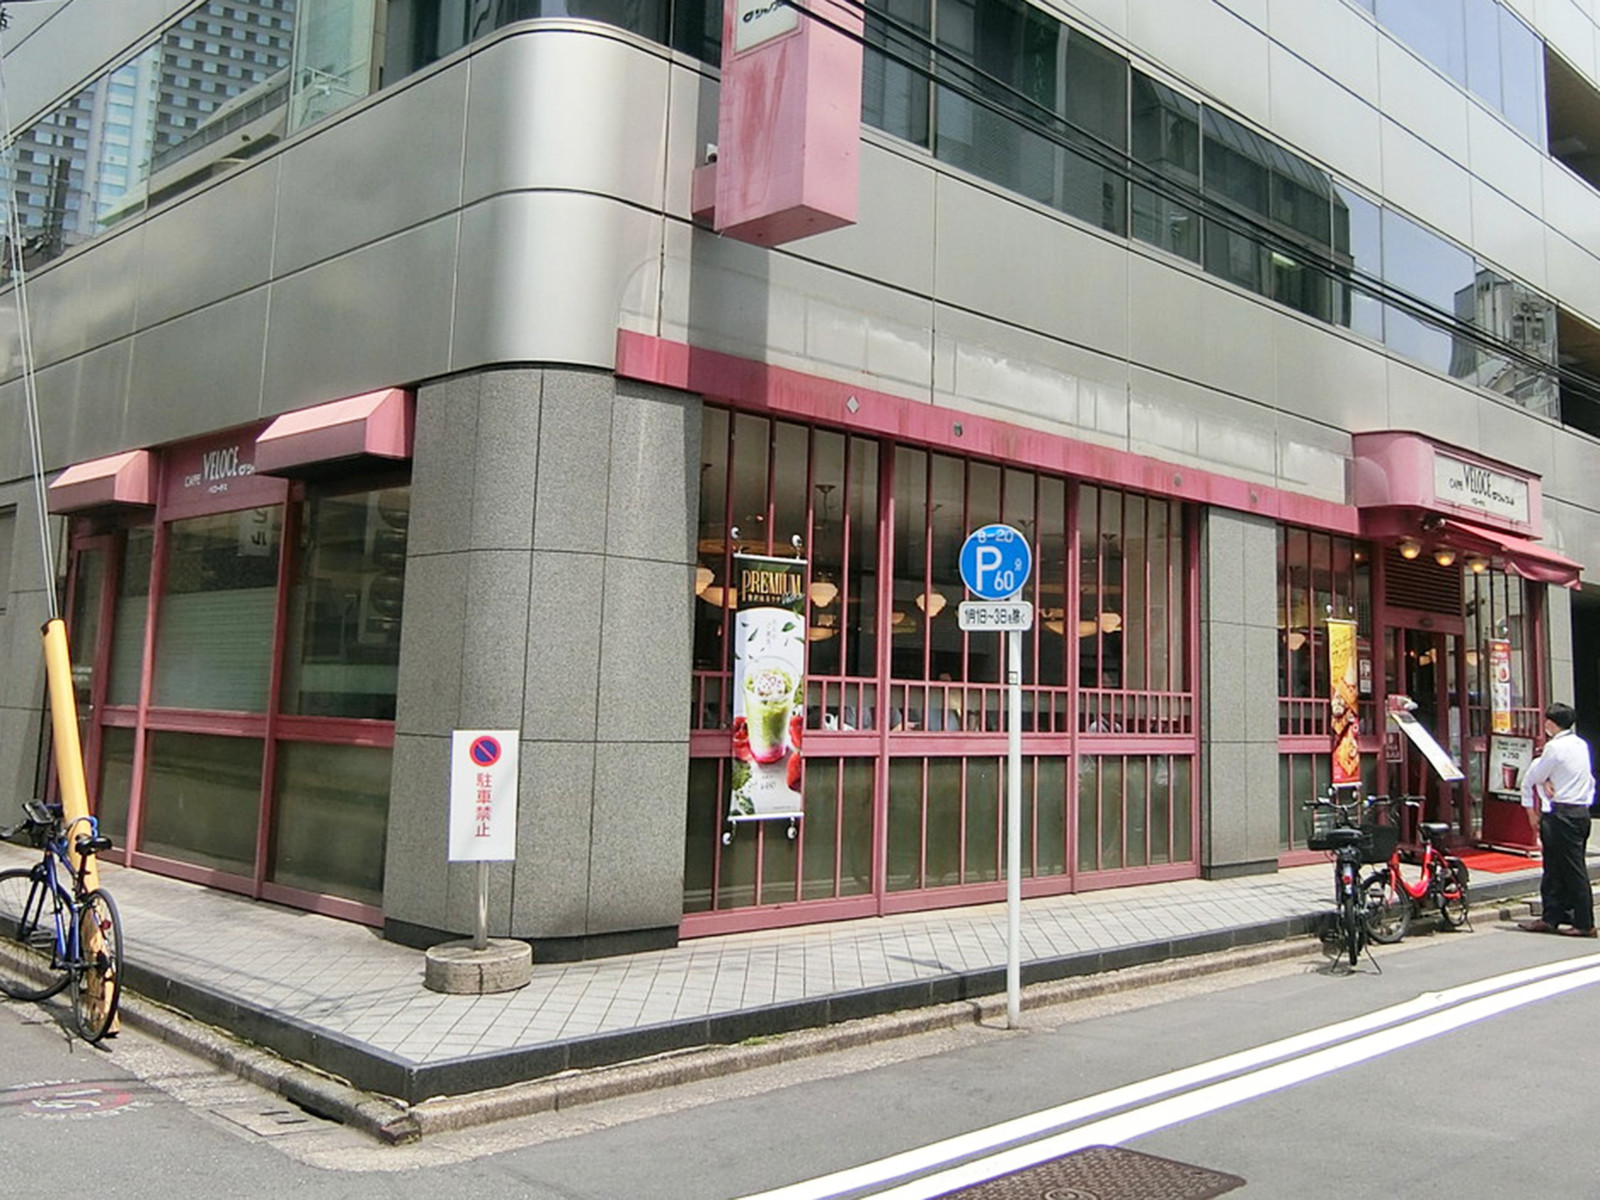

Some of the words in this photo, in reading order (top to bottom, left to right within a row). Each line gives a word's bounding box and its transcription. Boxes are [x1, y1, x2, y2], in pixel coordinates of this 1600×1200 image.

[203, 446, 239, 480] VELOCE
[1463, 465, 1491, 498] VELOCE
[976, 545, 1002, 591] P
[993, 570, 1014, 591] 60
[741, 569, 801, 602] PREMIUM
[475, 773, 492, 837] 駐車禁止
